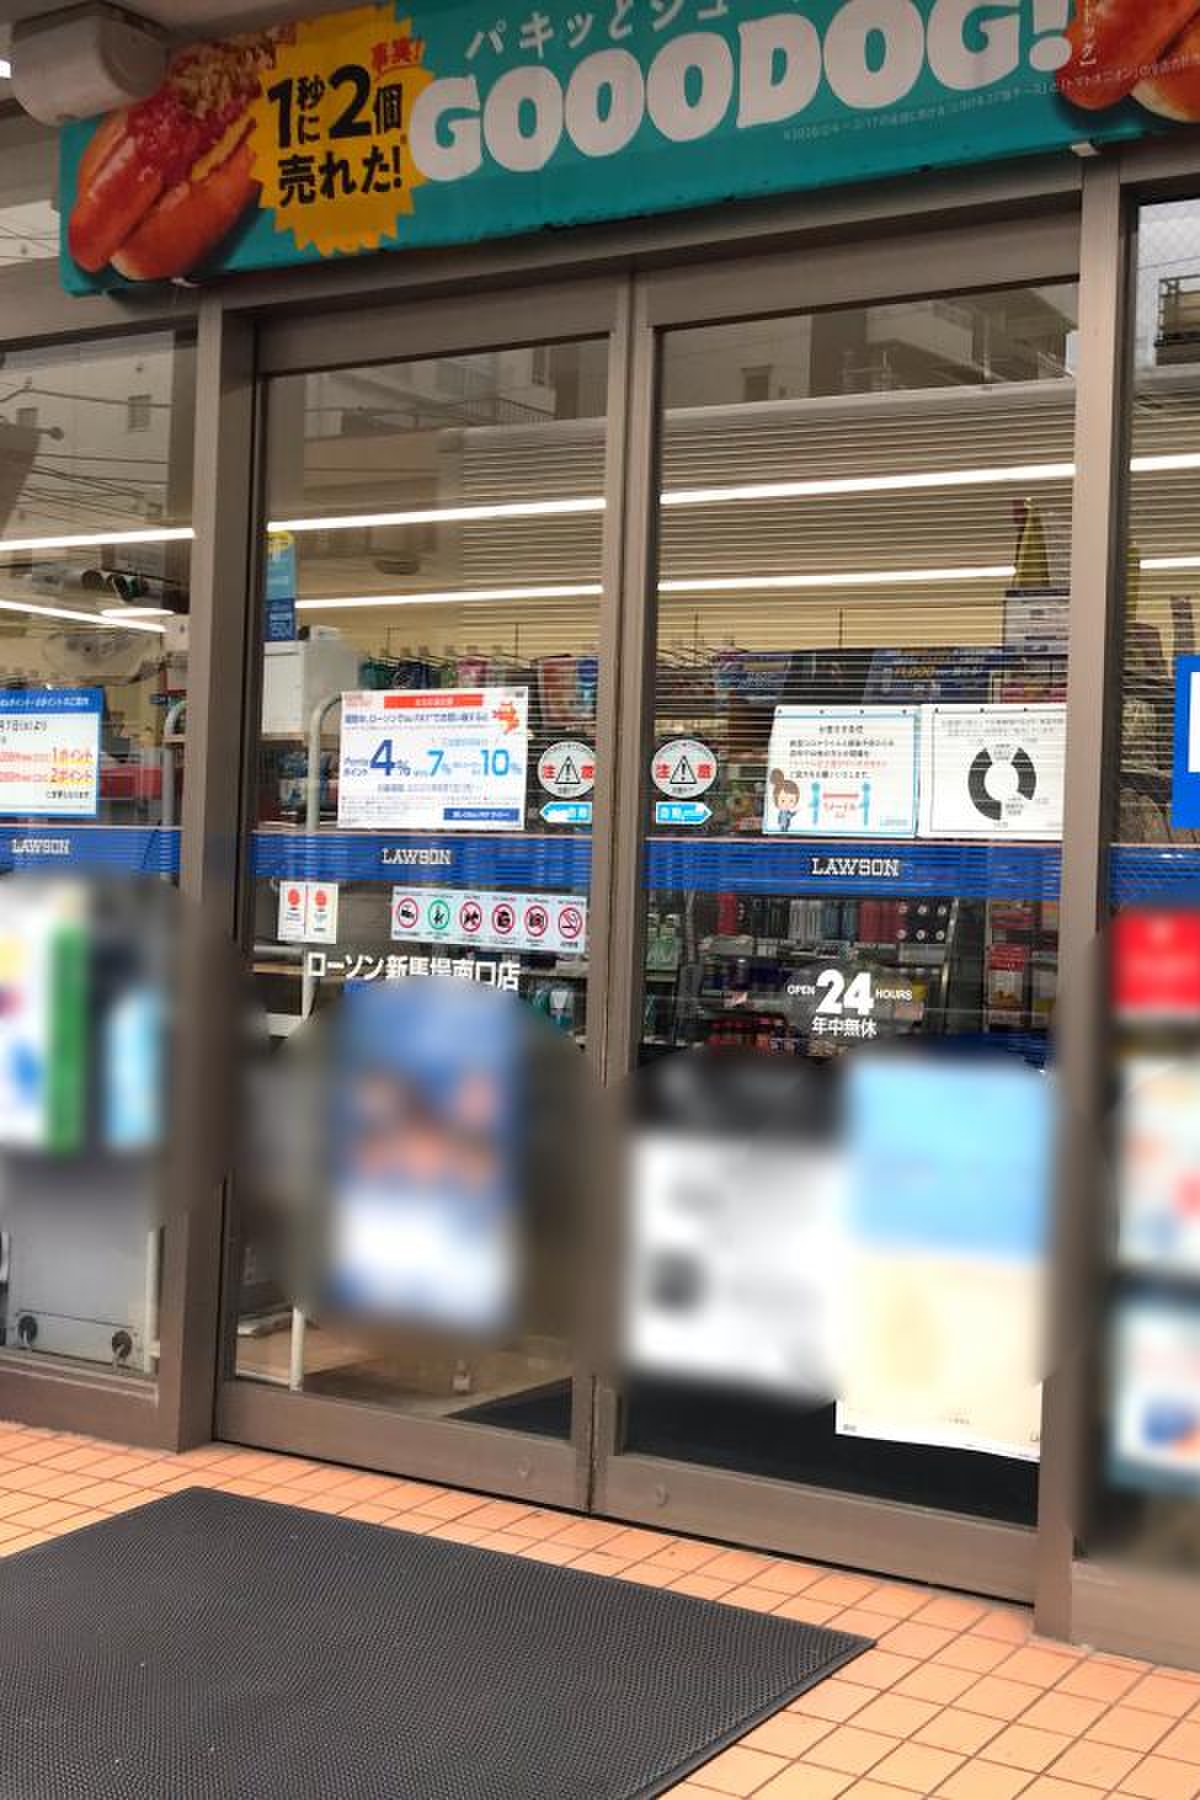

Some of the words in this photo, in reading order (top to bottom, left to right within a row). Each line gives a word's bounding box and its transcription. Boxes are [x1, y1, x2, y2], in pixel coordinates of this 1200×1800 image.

[409, 0, 1073, 182] GOOODOG!
[278, 145, 402, 208] 売れた!
[11, 838, 71, 856] LAWSON
[381, 848, 452, 865] LAWSON
[811, 857, 900, 877] LAWSON
[787, 985, 815, 996] OPEN
[815, 969, 875, 1016] 24
[875, 989, 912, 1001] HOURS
[811, 1017, 877, 1039] 年中無休
